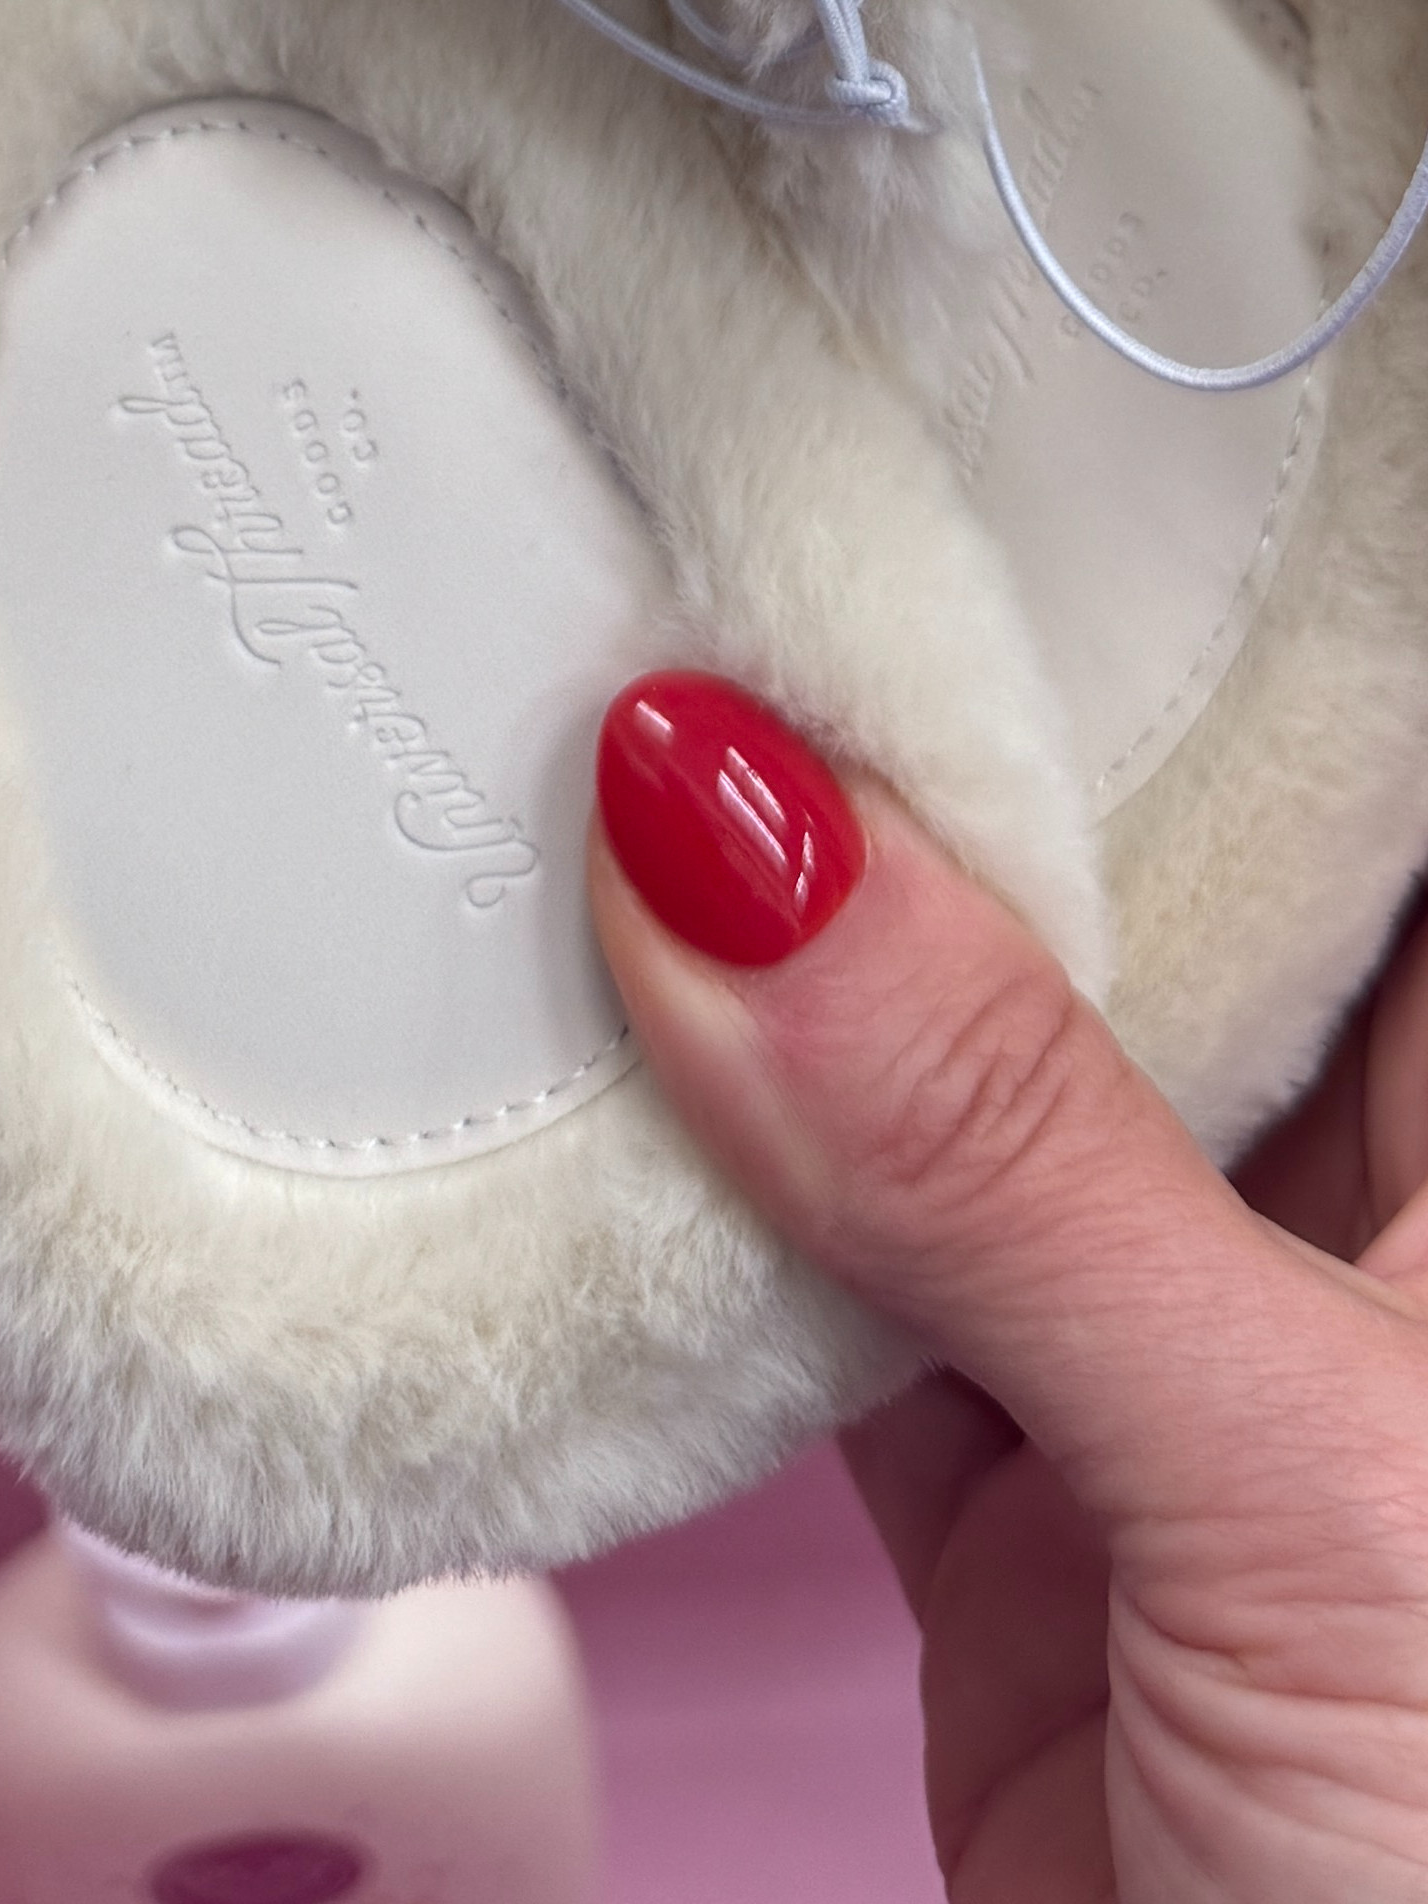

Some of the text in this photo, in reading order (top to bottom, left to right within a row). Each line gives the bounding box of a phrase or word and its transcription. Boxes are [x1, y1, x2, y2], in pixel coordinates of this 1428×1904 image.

[279, 374, 356, 530] GOODS
[336, 382, 381, 467] CO.
[255, 603, 541, 910] Universal
